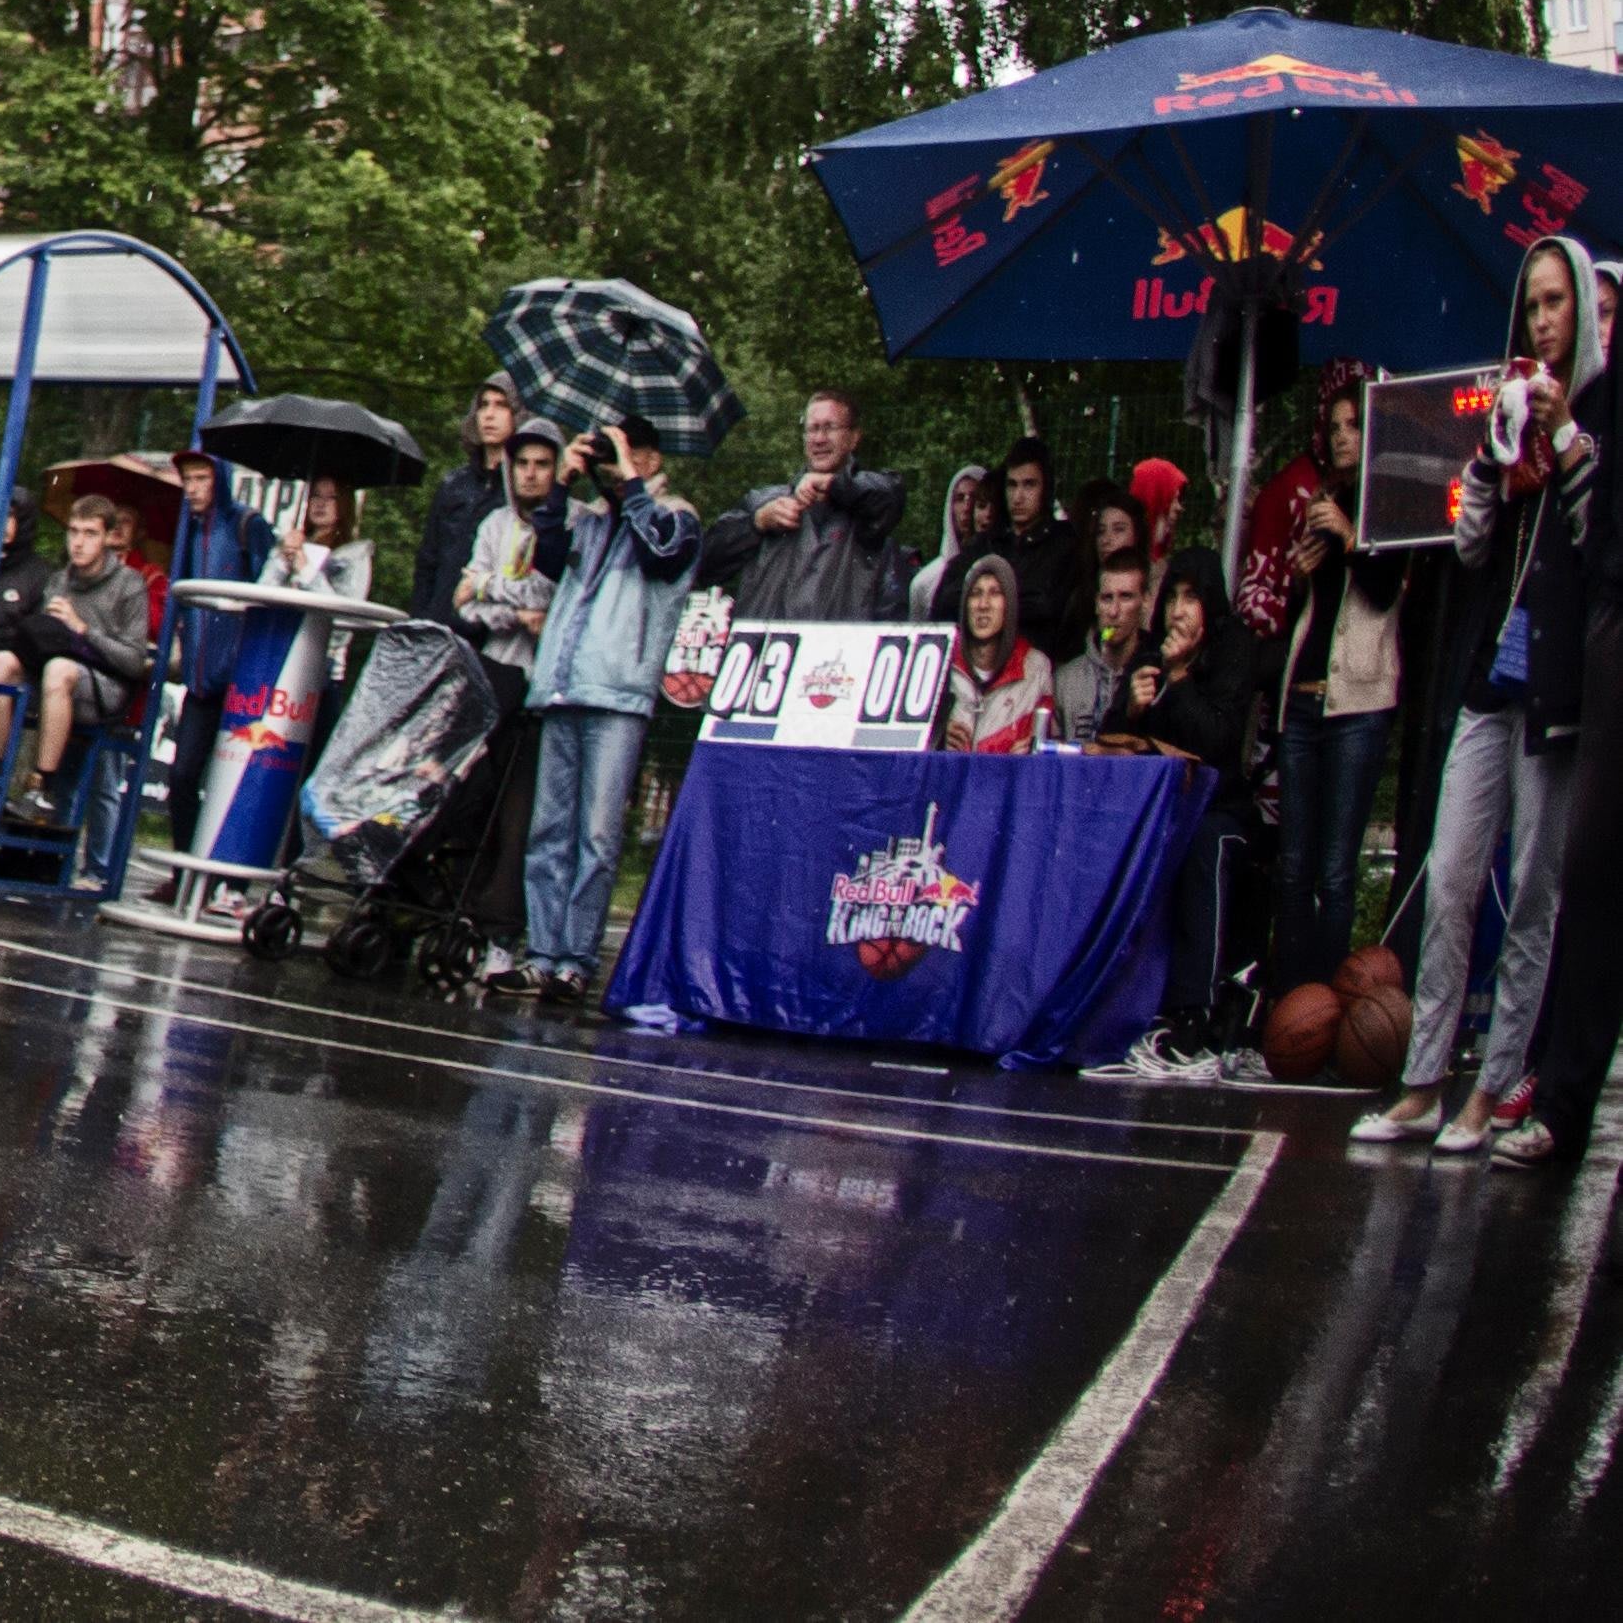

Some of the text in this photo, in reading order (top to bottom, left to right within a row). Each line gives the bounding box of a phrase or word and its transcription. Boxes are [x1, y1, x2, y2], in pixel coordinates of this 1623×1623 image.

[1153, 75, 1419, 115] Red Bull
[863, 643, 942, 718] 00
[834, 876, 916, 904] Red Bull
[826, 899, 889, 944] KING
[902, 903, 969, 952] ROCK
